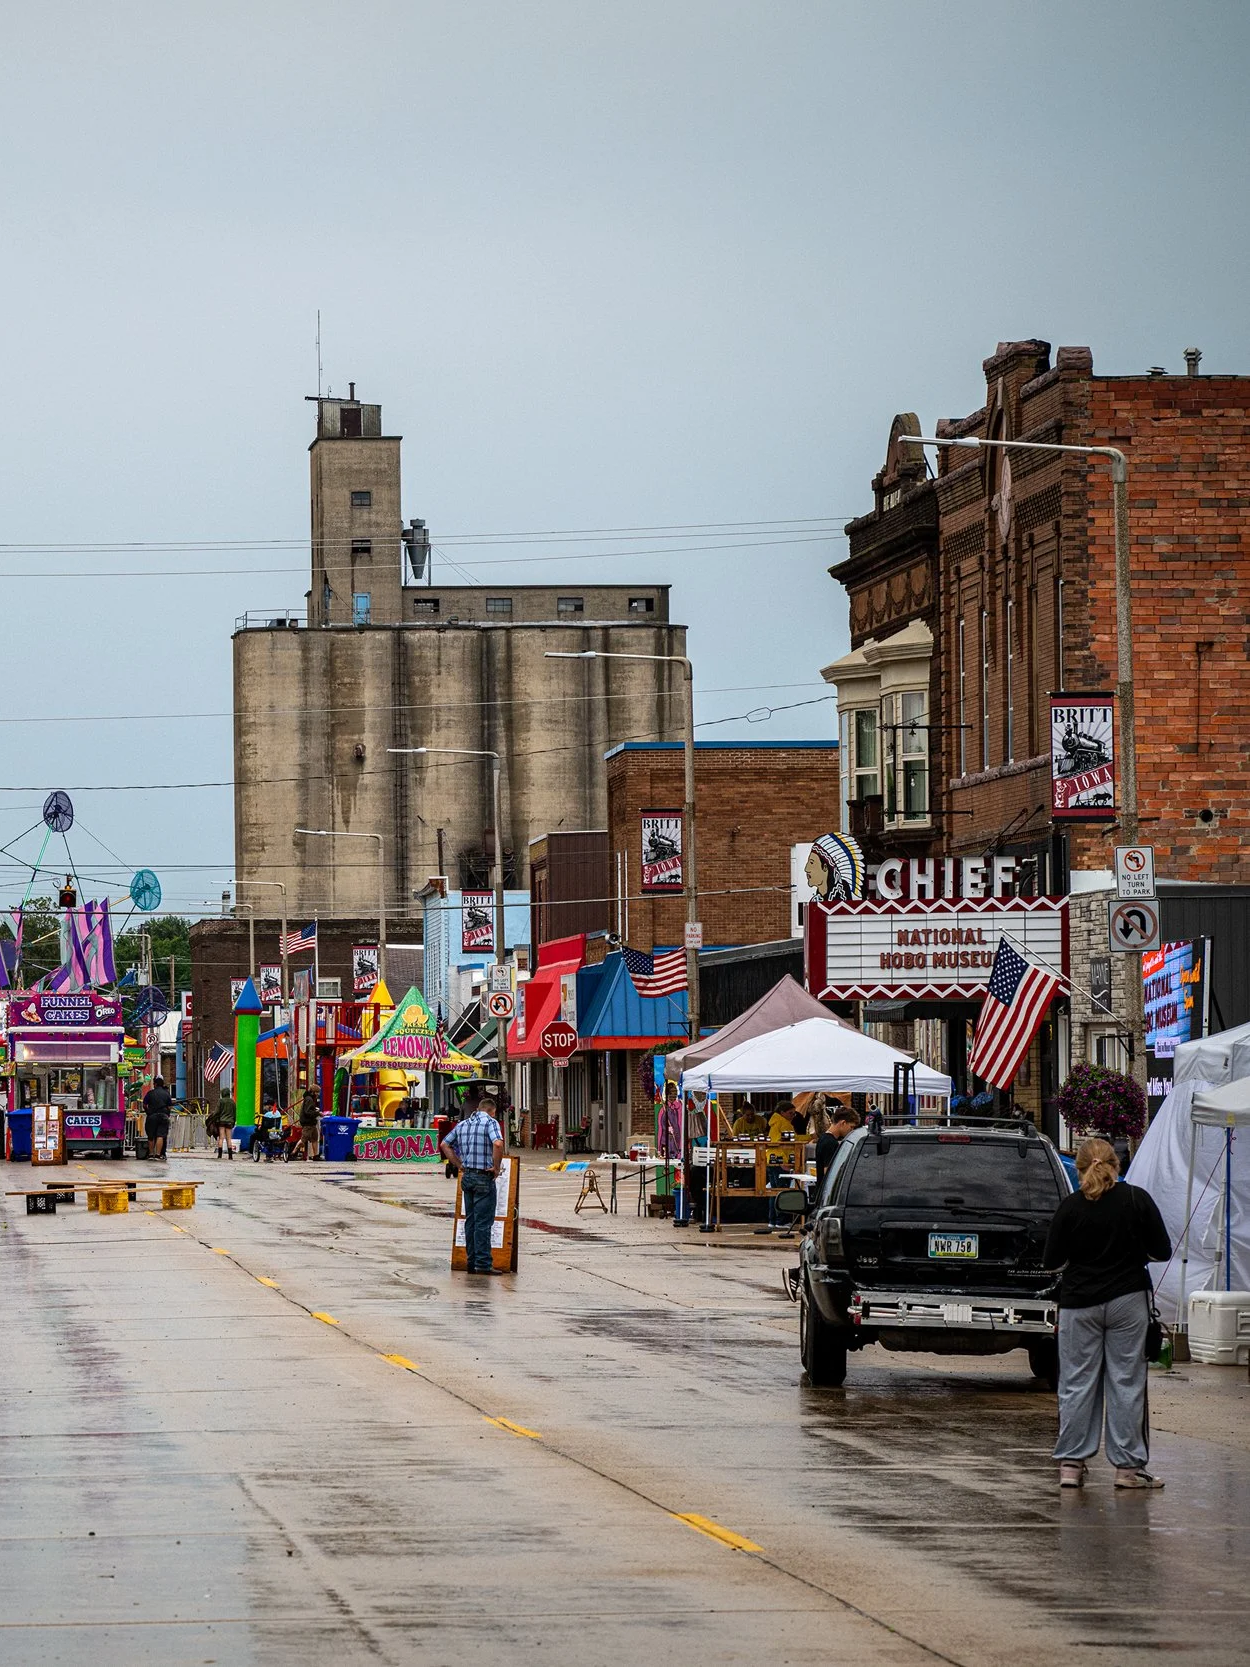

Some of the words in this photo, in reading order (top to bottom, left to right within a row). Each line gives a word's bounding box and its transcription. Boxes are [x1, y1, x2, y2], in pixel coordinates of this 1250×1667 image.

[1054, 708, 1111, 723] BRITT
[1074, 768, 1112, 792] IOWA
[643, 819, 681, 829] BRITT
[656, 858, 681, 874] IOWA
[877, 856, 1016, 900] CHIEF
[463, 896, 492, 904] BRITT
[897, 927, 987, 947] NATIONAL
[880, 952, 926, 970] HOBO
[932, 950, 998, 969] MUSEU
[40, 996, 92, 1008] FUNNEL
[44, 1009, 90, 1021] CAKES
[395, 1028, 436, 1036] SQUEEZED
[544, 1033, 575, 1047] STOP
[382, 1035, 449, 1059] LEMONAE
[360, 1060, 385, 1068] FRESH
[388, 1061, 428, 1070] SQUEEZED
[439, 1062, 474, 1071] MONADE
[66, 1116, 101, 1126] CAKES
[354, 1134, 440, 1160] LEMONA
[935, 1240, 952, 1252] NWR
[956, 1240, 971, 1252] 750
[856, 1255, 878, 1264] Jeep
